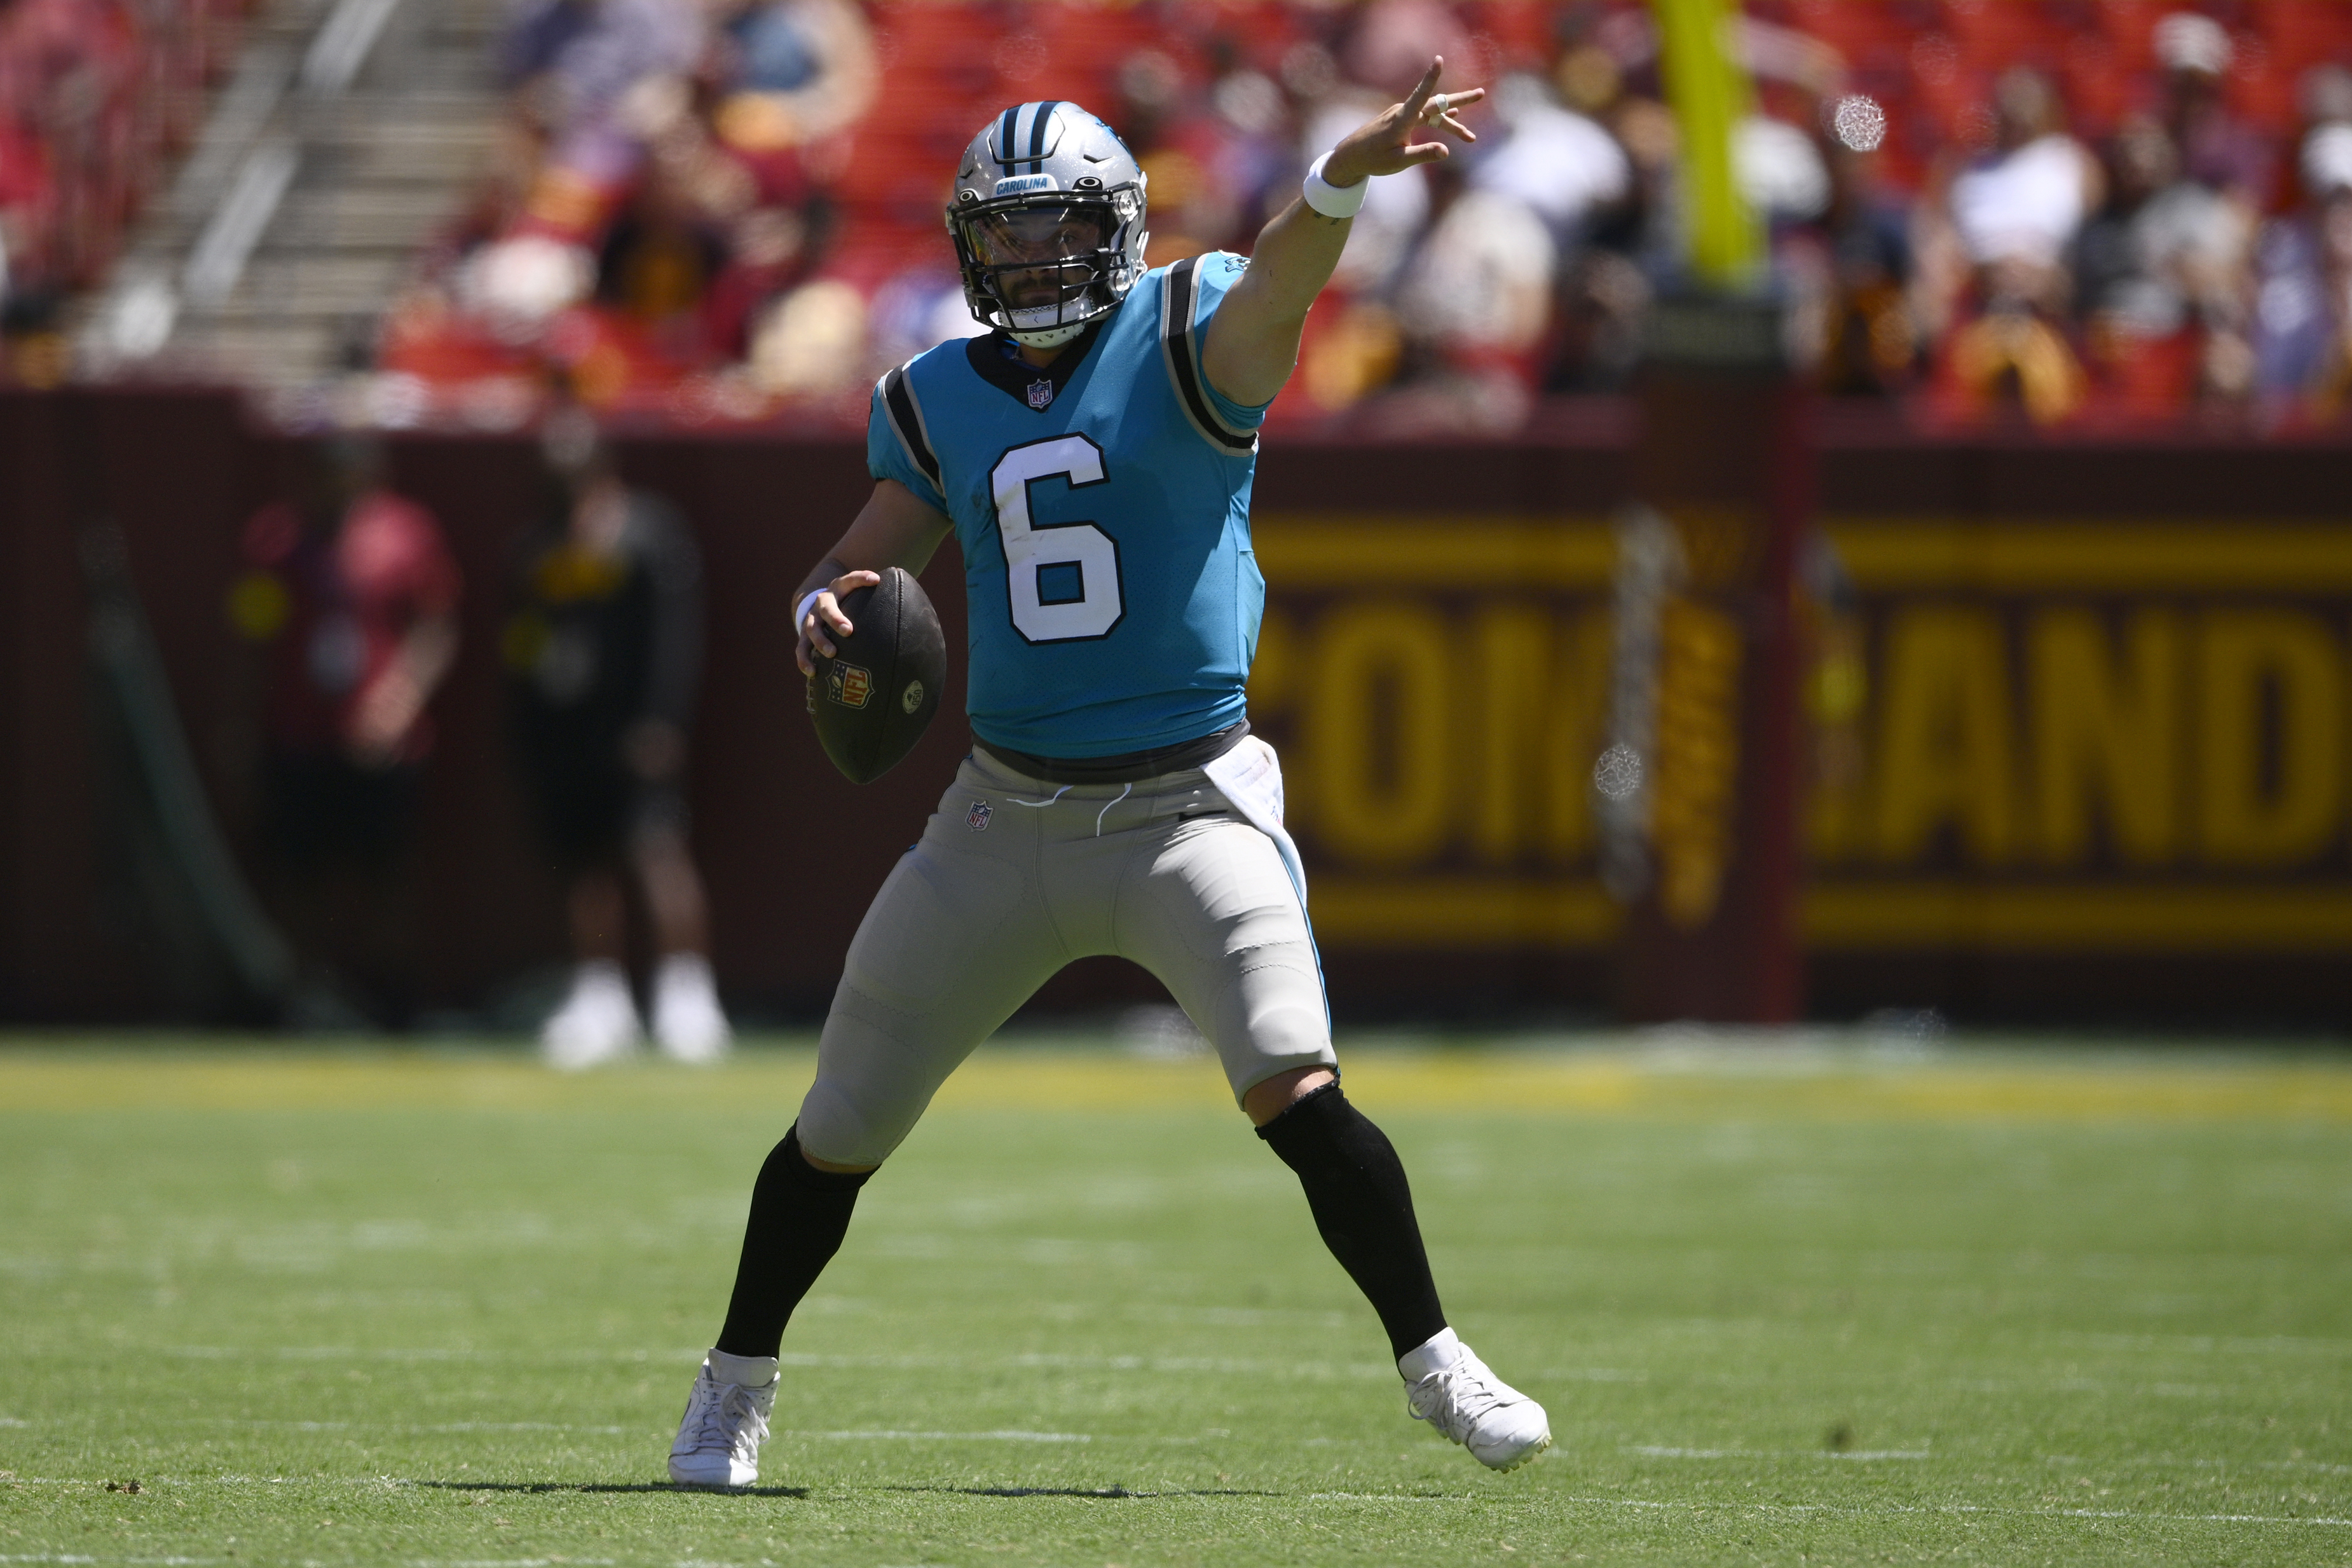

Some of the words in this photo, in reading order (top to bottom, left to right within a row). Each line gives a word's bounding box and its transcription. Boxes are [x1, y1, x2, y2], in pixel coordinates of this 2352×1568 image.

[996, 177, 1048, 195] CAROLINA
[1032, 390, 1048, 403] NFL
[988, 431, 1126, 646] 6
[843, 671, 868, 706] NFL
[1246, 599, 2347, 857] OMAND
[969, 812, 985, 826] NFL
